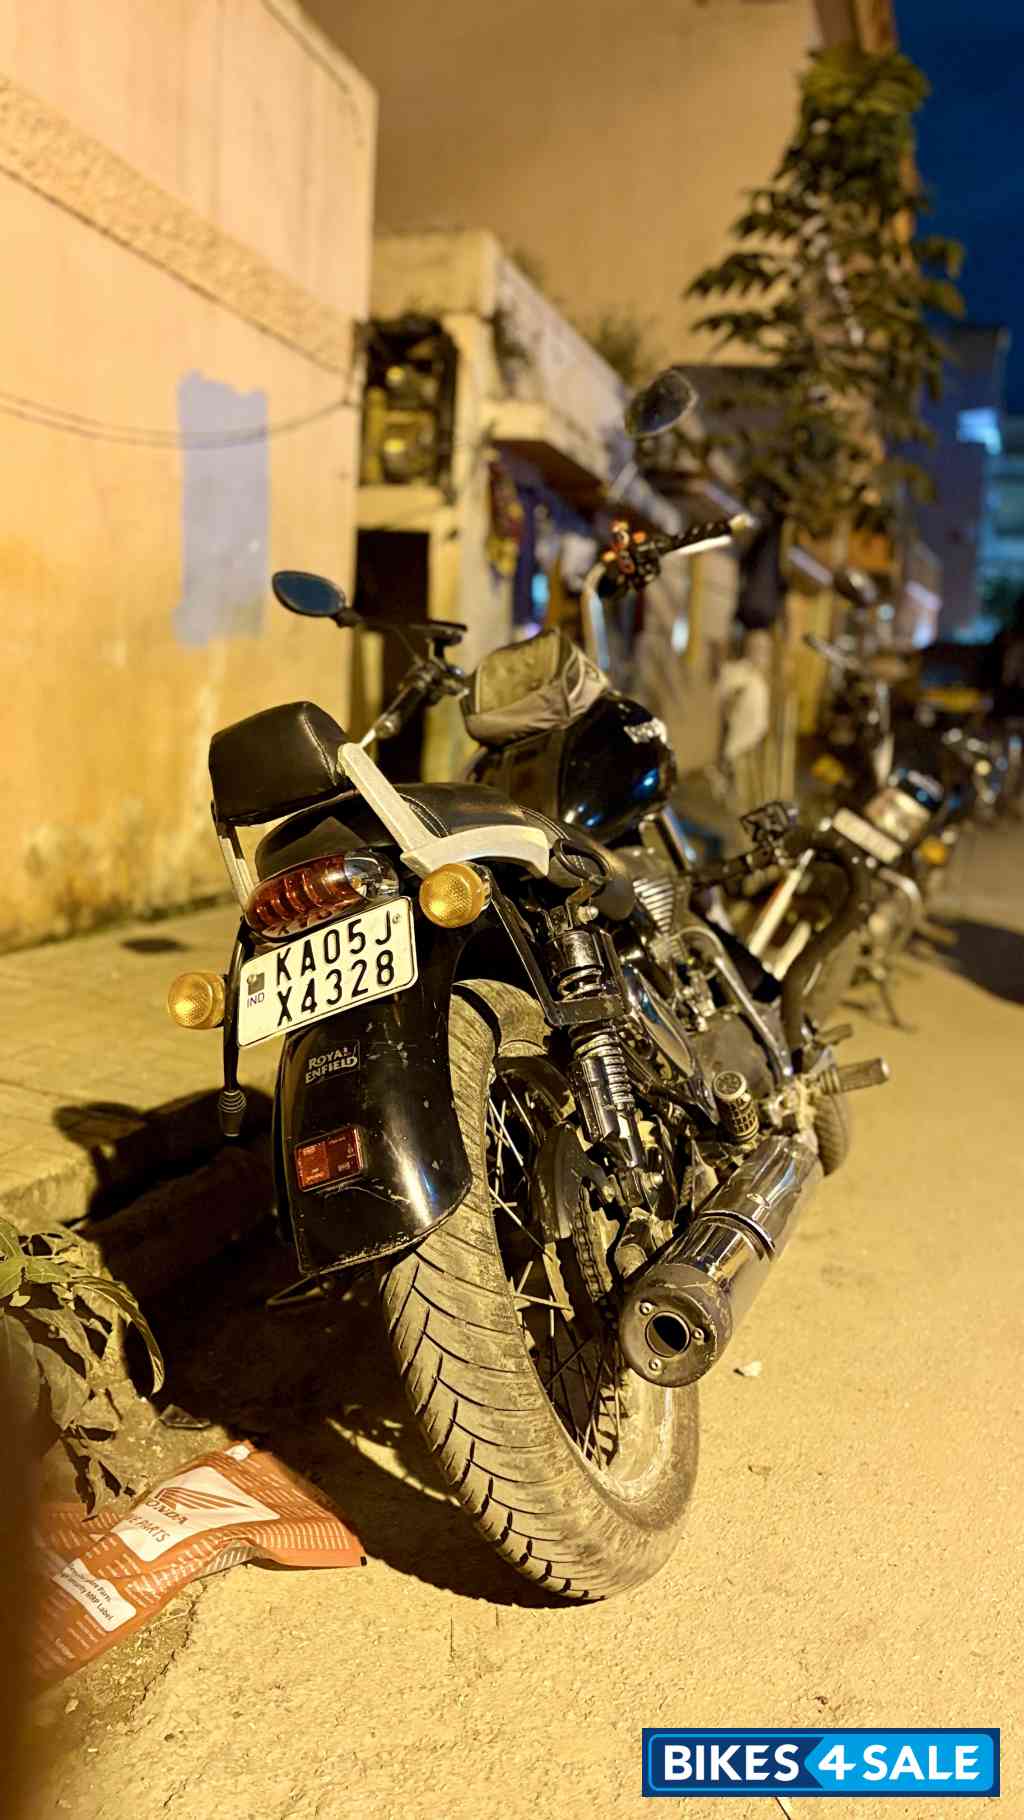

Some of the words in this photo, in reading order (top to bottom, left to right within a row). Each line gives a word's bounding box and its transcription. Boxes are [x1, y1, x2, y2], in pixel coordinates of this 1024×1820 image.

[247, 991, 265, 1008] IND
[277, 949, 395, 1026] X4328
[305, 1056, 358, 1085] ENFIELD
[308, 1046, 352, 1070] ROYAL
[145, 1498, 189, 1525] ONDA
